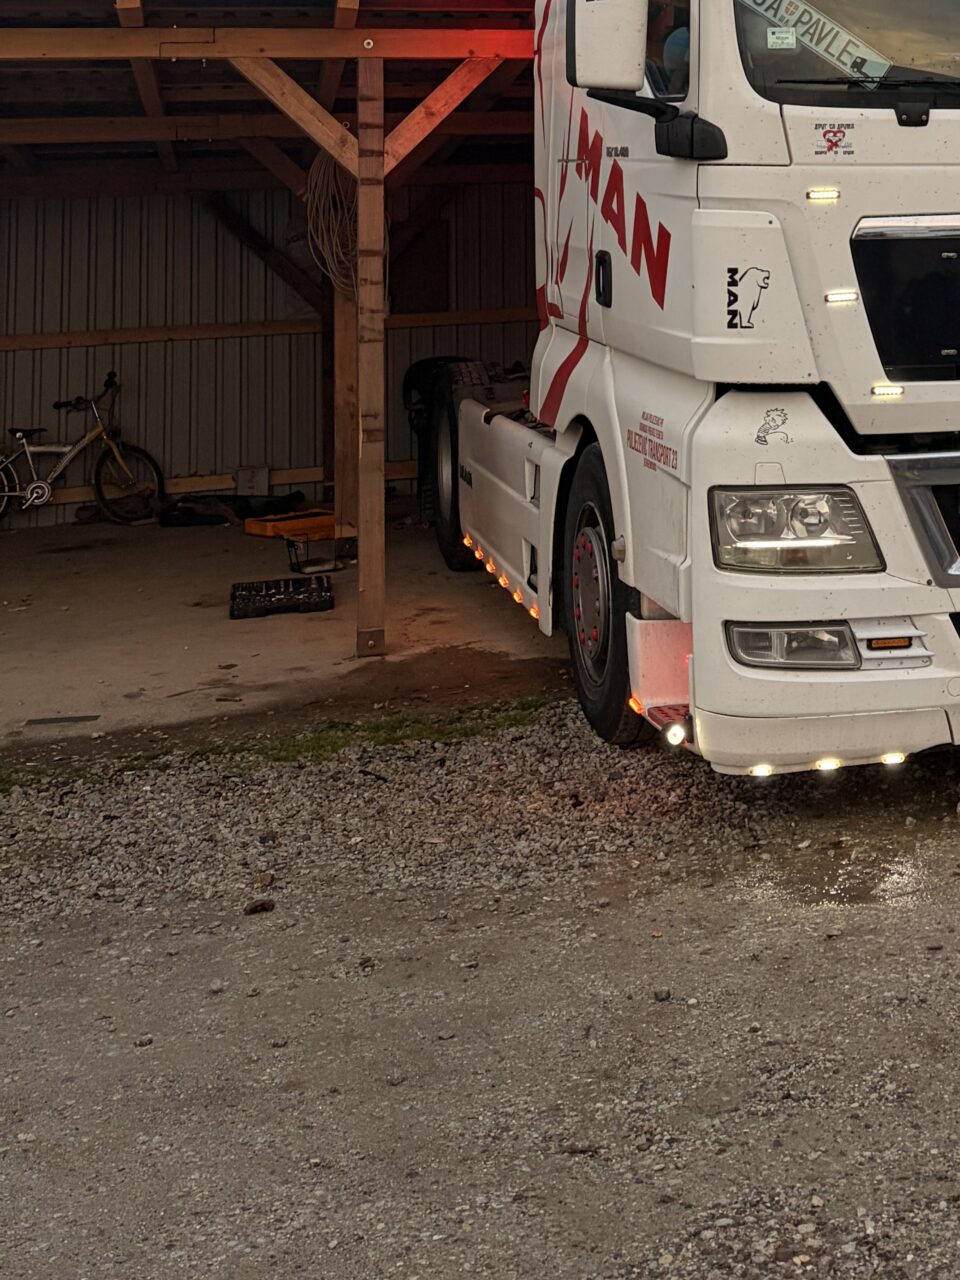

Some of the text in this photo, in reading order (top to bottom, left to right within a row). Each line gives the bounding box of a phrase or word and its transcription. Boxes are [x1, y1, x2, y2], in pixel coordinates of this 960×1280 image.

[792, 7, 860, 67] PAVLE
[576, 106, 672, 311] MAN
[727, 267, 739, 329] MAN
